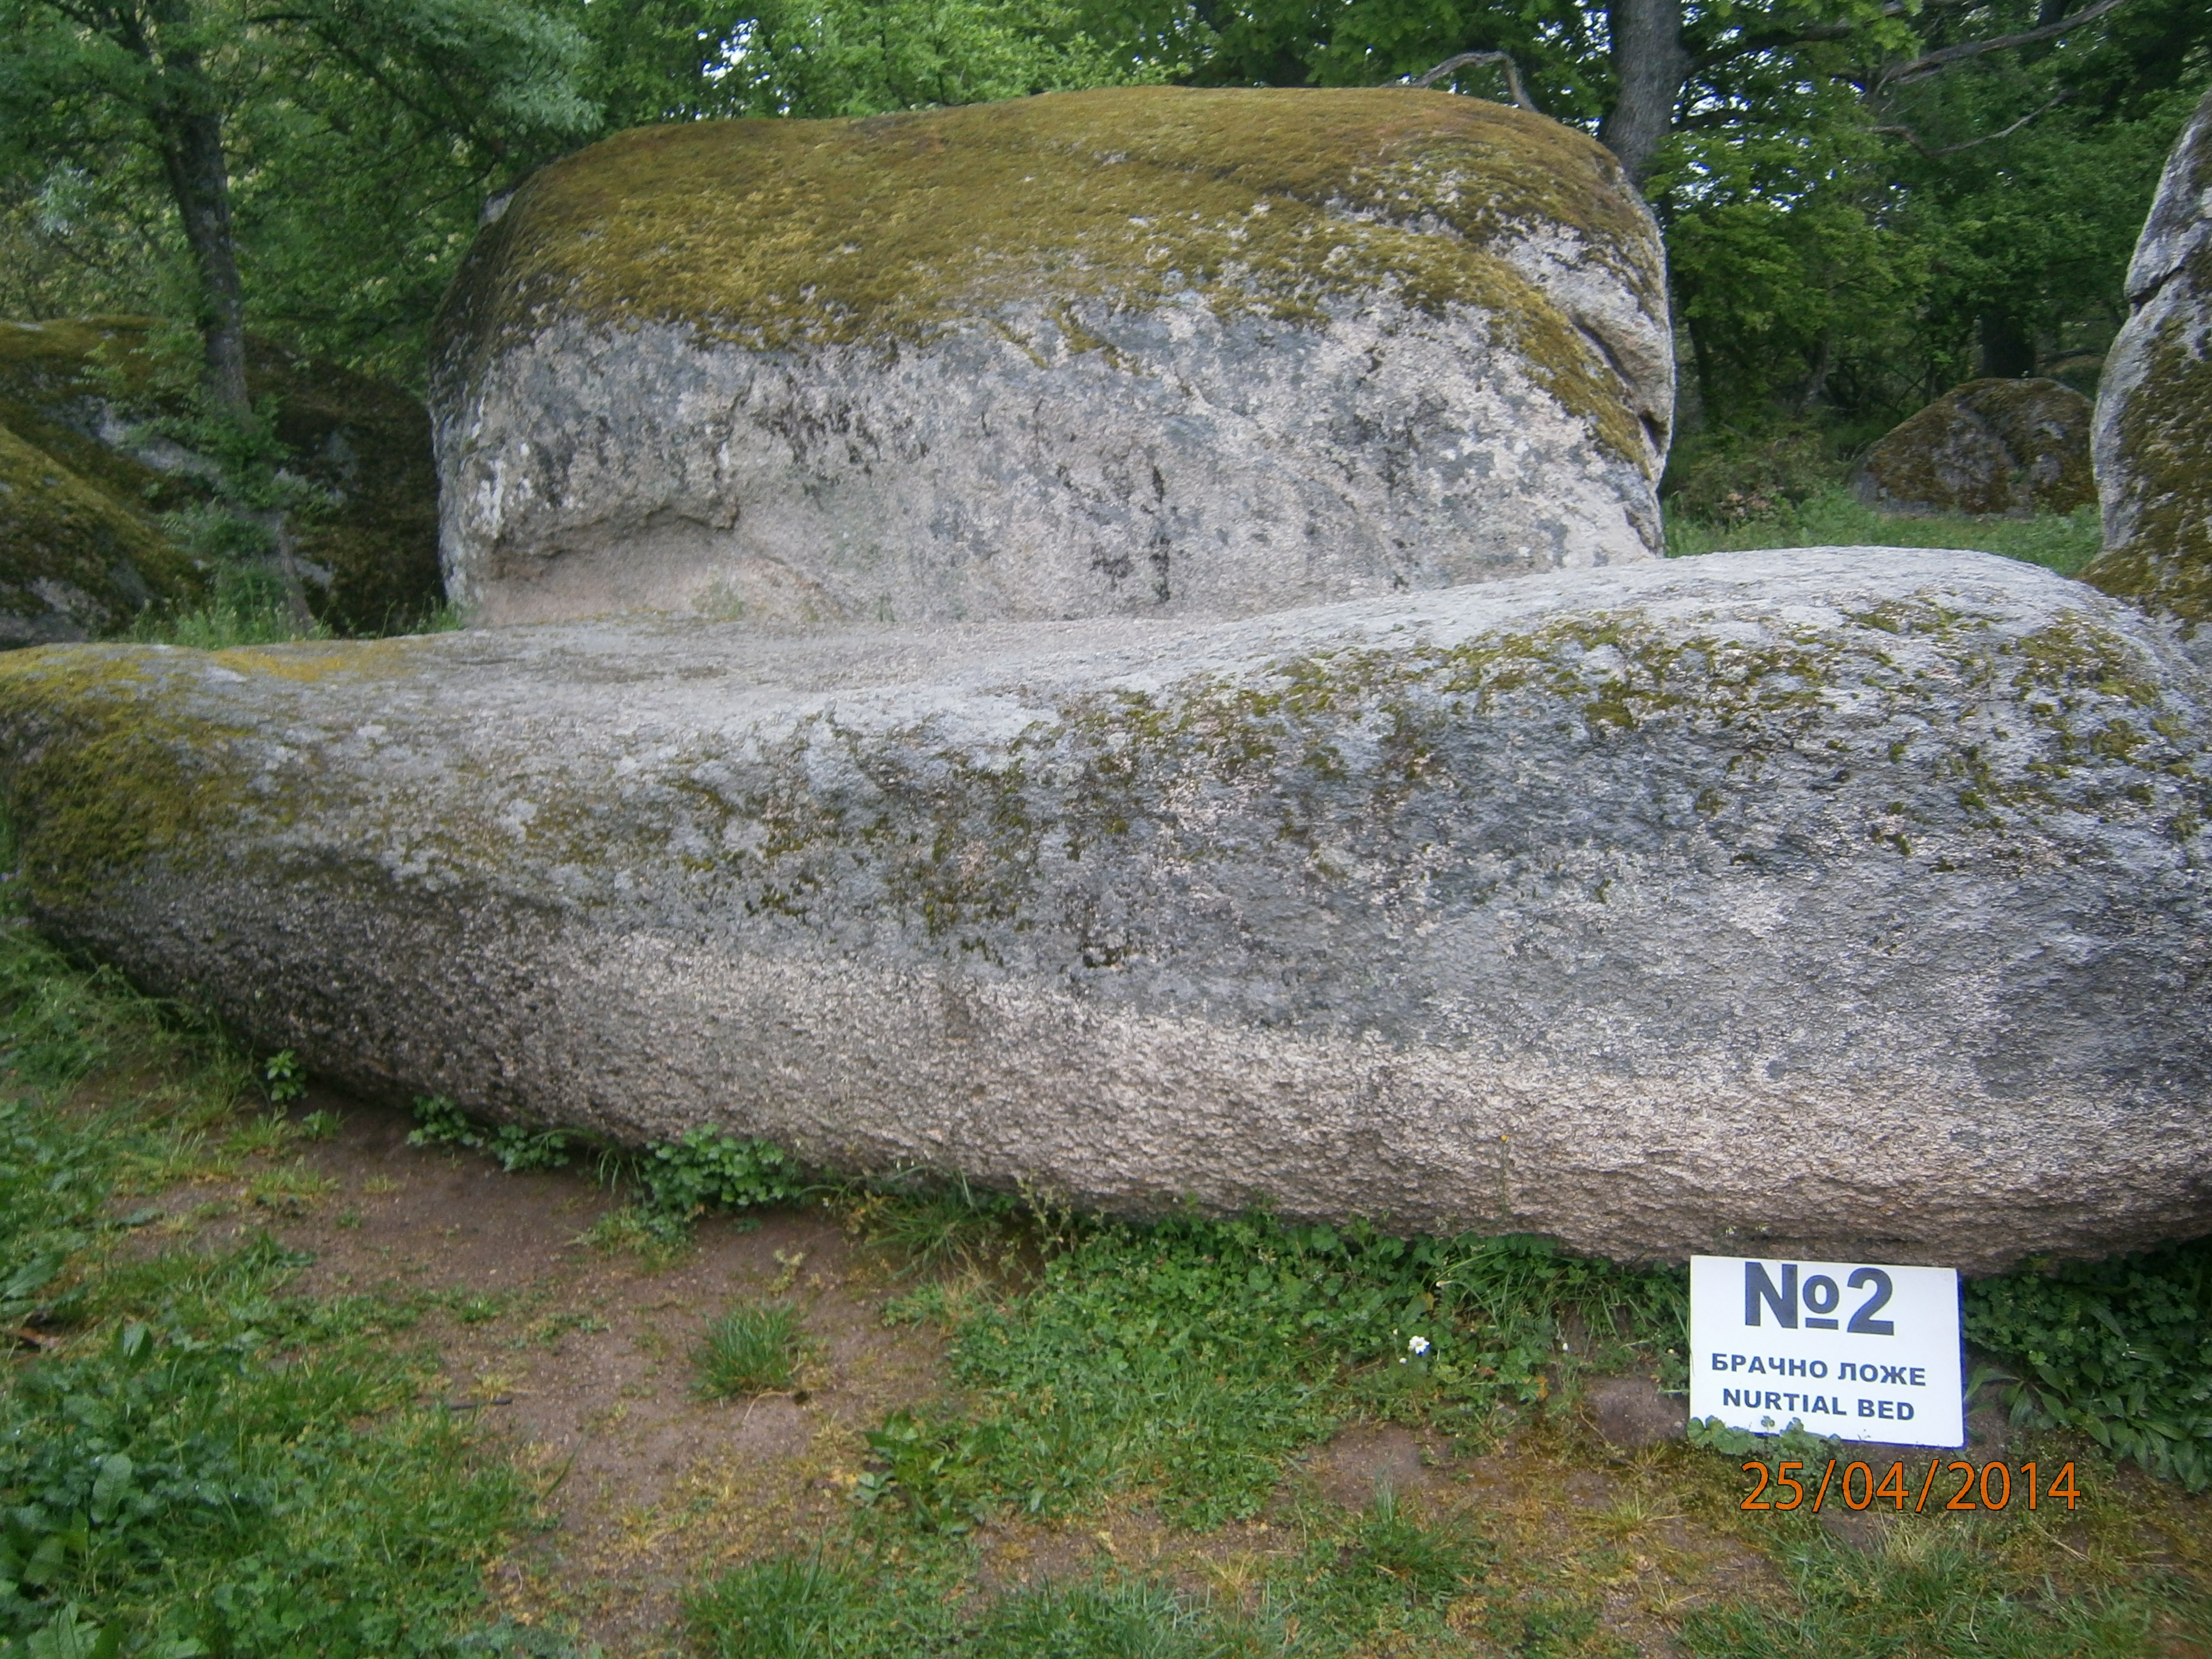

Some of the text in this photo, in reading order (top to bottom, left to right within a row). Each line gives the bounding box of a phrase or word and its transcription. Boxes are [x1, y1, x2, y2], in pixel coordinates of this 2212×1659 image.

[1711, 1353, 1926, 1387] БРАЧНО ЛОЖЕ
[1722, 1388, 1914, 1421] NURTIAL BED
